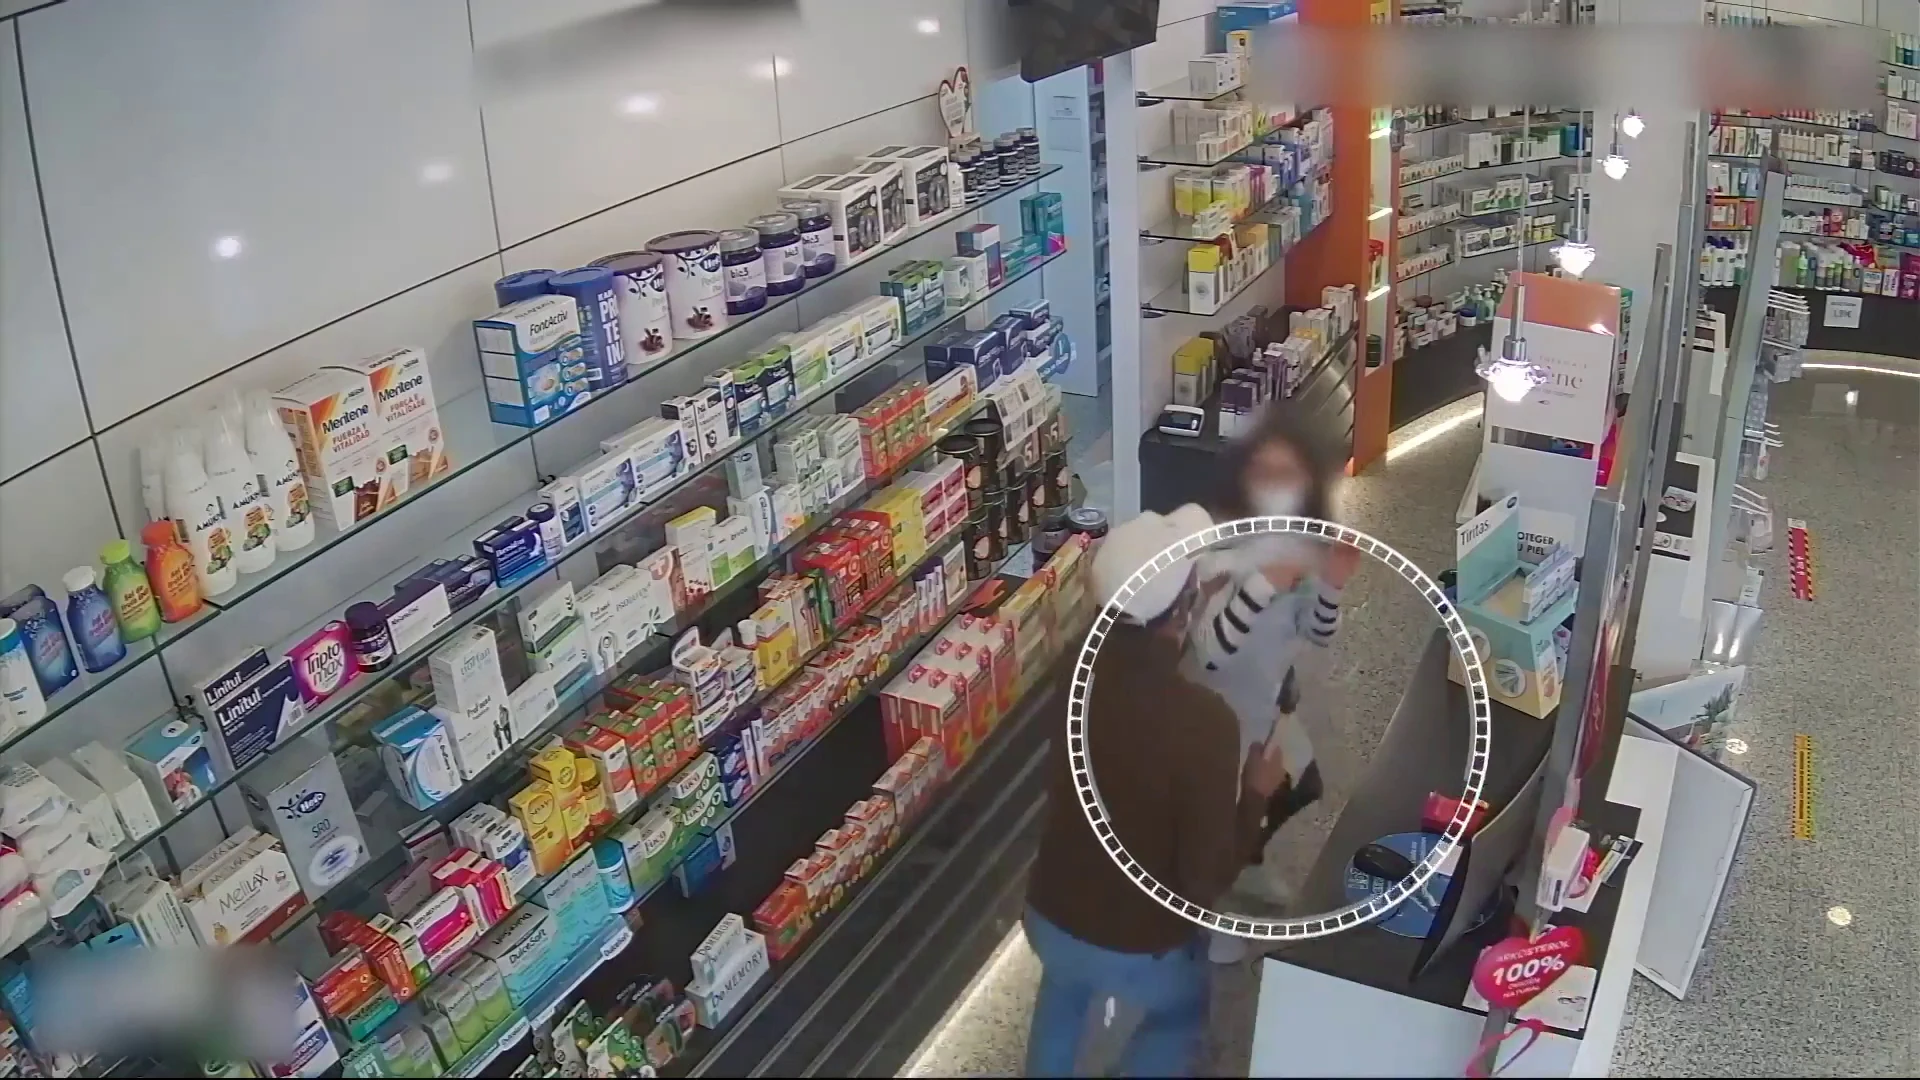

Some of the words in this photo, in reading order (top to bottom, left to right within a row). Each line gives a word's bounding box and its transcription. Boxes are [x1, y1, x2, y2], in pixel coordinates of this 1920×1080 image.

[730, 266, 749, 279] bio3
[529, 310, 568, 337] FontActiv
[602, 319, 620, 344] TE
[378, 375, 423, 403] Meritene
[322, 404, 369, 434] Meritene
[332, 427, 360, 444] FUERZA
[332, 430, 370, 453] VITALIDAD
[1460, 518, 1490, 546] Tiritas
[1517, 531, 1554, 546] OTEGER
[1526, 544, 1545, 556] PIEL
[304, 642, 340, 675] Tripto
[313, 657, 343, 686] max
[206, 671, 243, 705] Linitul
[218, 687, 262, 727] Linitul
[300, 793, 323, 812] Hero
[312, 818, 331, 838] SRO
[1493, 953, 1565, 986] 100%
